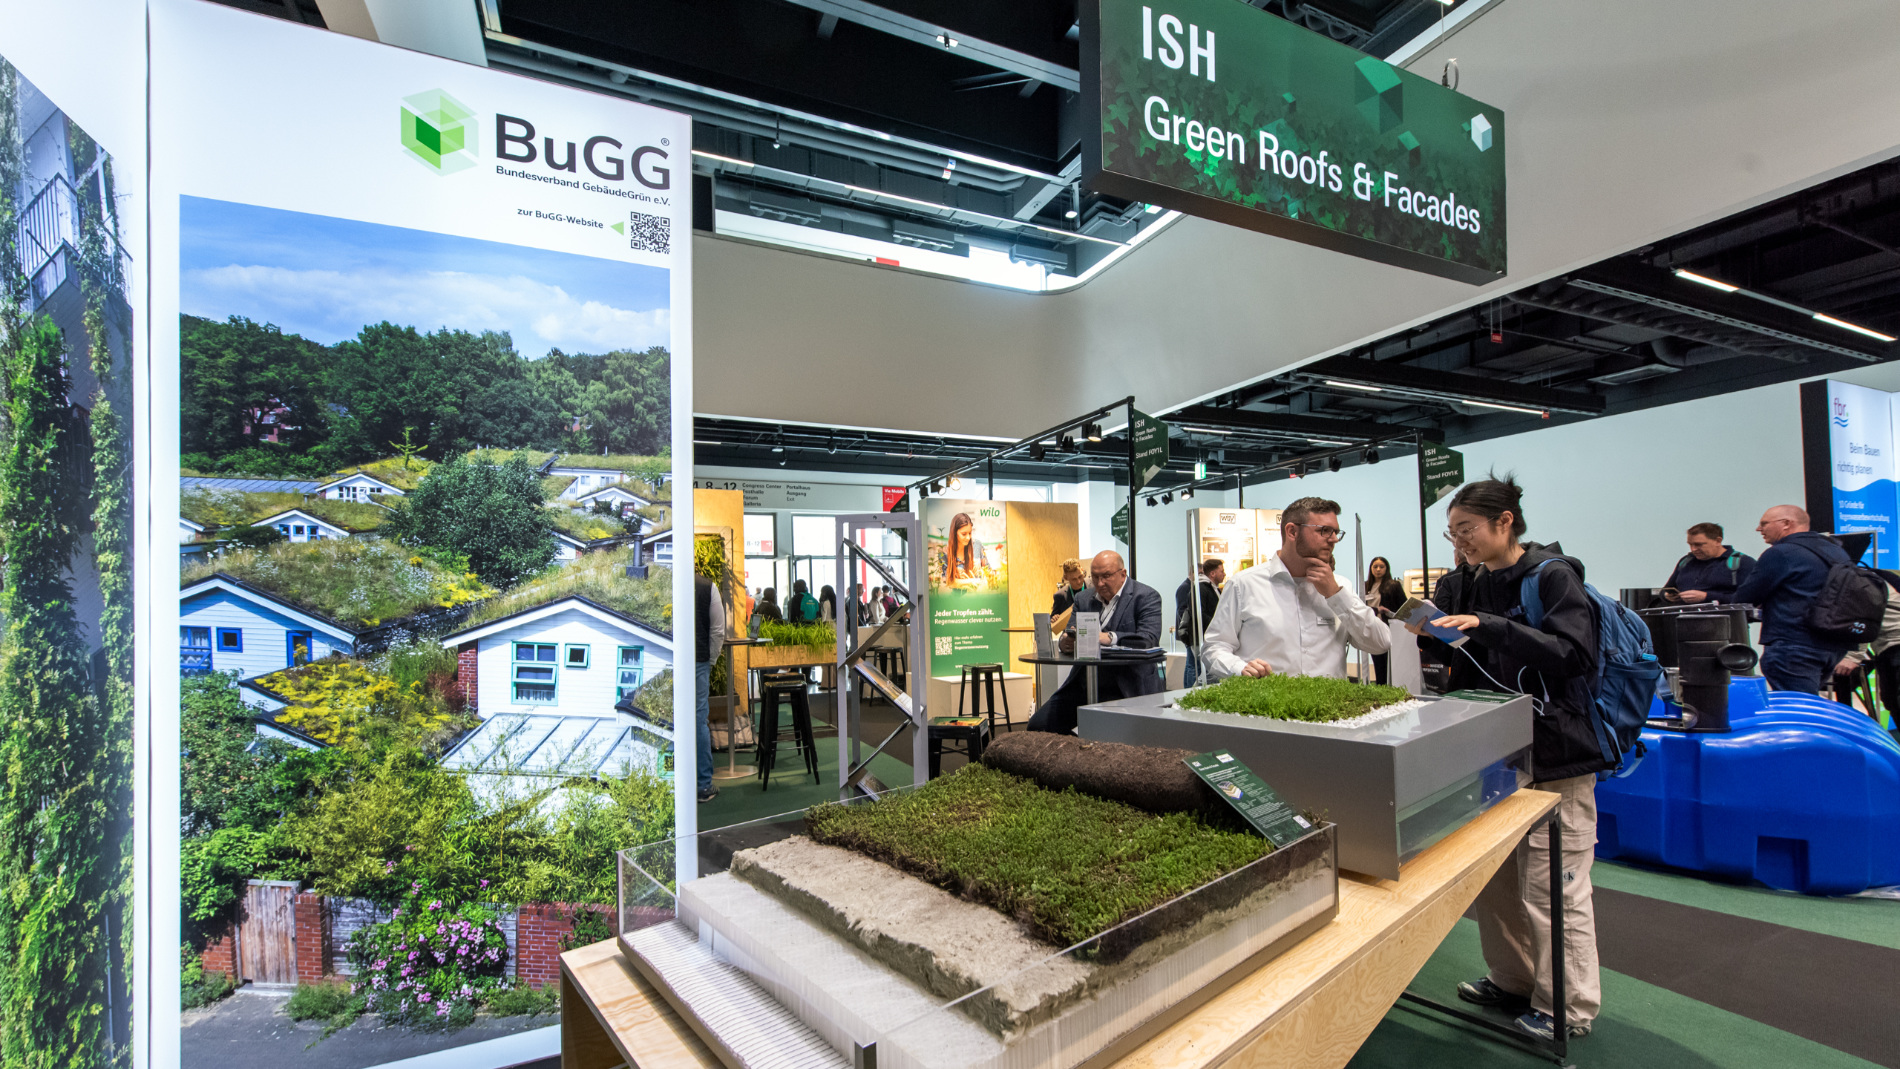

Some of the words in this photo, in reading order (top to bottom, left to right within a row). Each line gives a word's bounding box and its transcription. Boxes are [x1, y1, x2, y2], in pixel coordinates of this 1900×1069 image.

[1141, 5, 1217, 83] ISH
[496, 113, 670, 190] BuGG
[1143, 95, 1246, 165] Green
[1258, 129, 1344, 193] Roofs
[1352, 162, 1375, 201] &
[1383, 171, 1482, 235] Facades
[496, 165, 580, 190] Bundesverband
[581, 181, 652, 203] GebäudeGrün
[653, 195, 671, 207] e.V.
[517, 208, 533, 218] zur
[535, 209, 604, 230] BuGG-Website
[1135, 419, 1145, 428] ISH
[1425, 448, 1436, 456] ISH
[1849, 442, 1863, 455] Beim
[1864, 444, 1880, 457] Bauen
[1836, 461, 1854, 476] richtig
[1855, 463, 1873, 475] planen
[980, 507, 1000, 517] wilo
[952, 609, 977, 617] Tropfen
[977, 608, 995, 616] zählt.
[934, 618, 968, 626] Regenwasser
